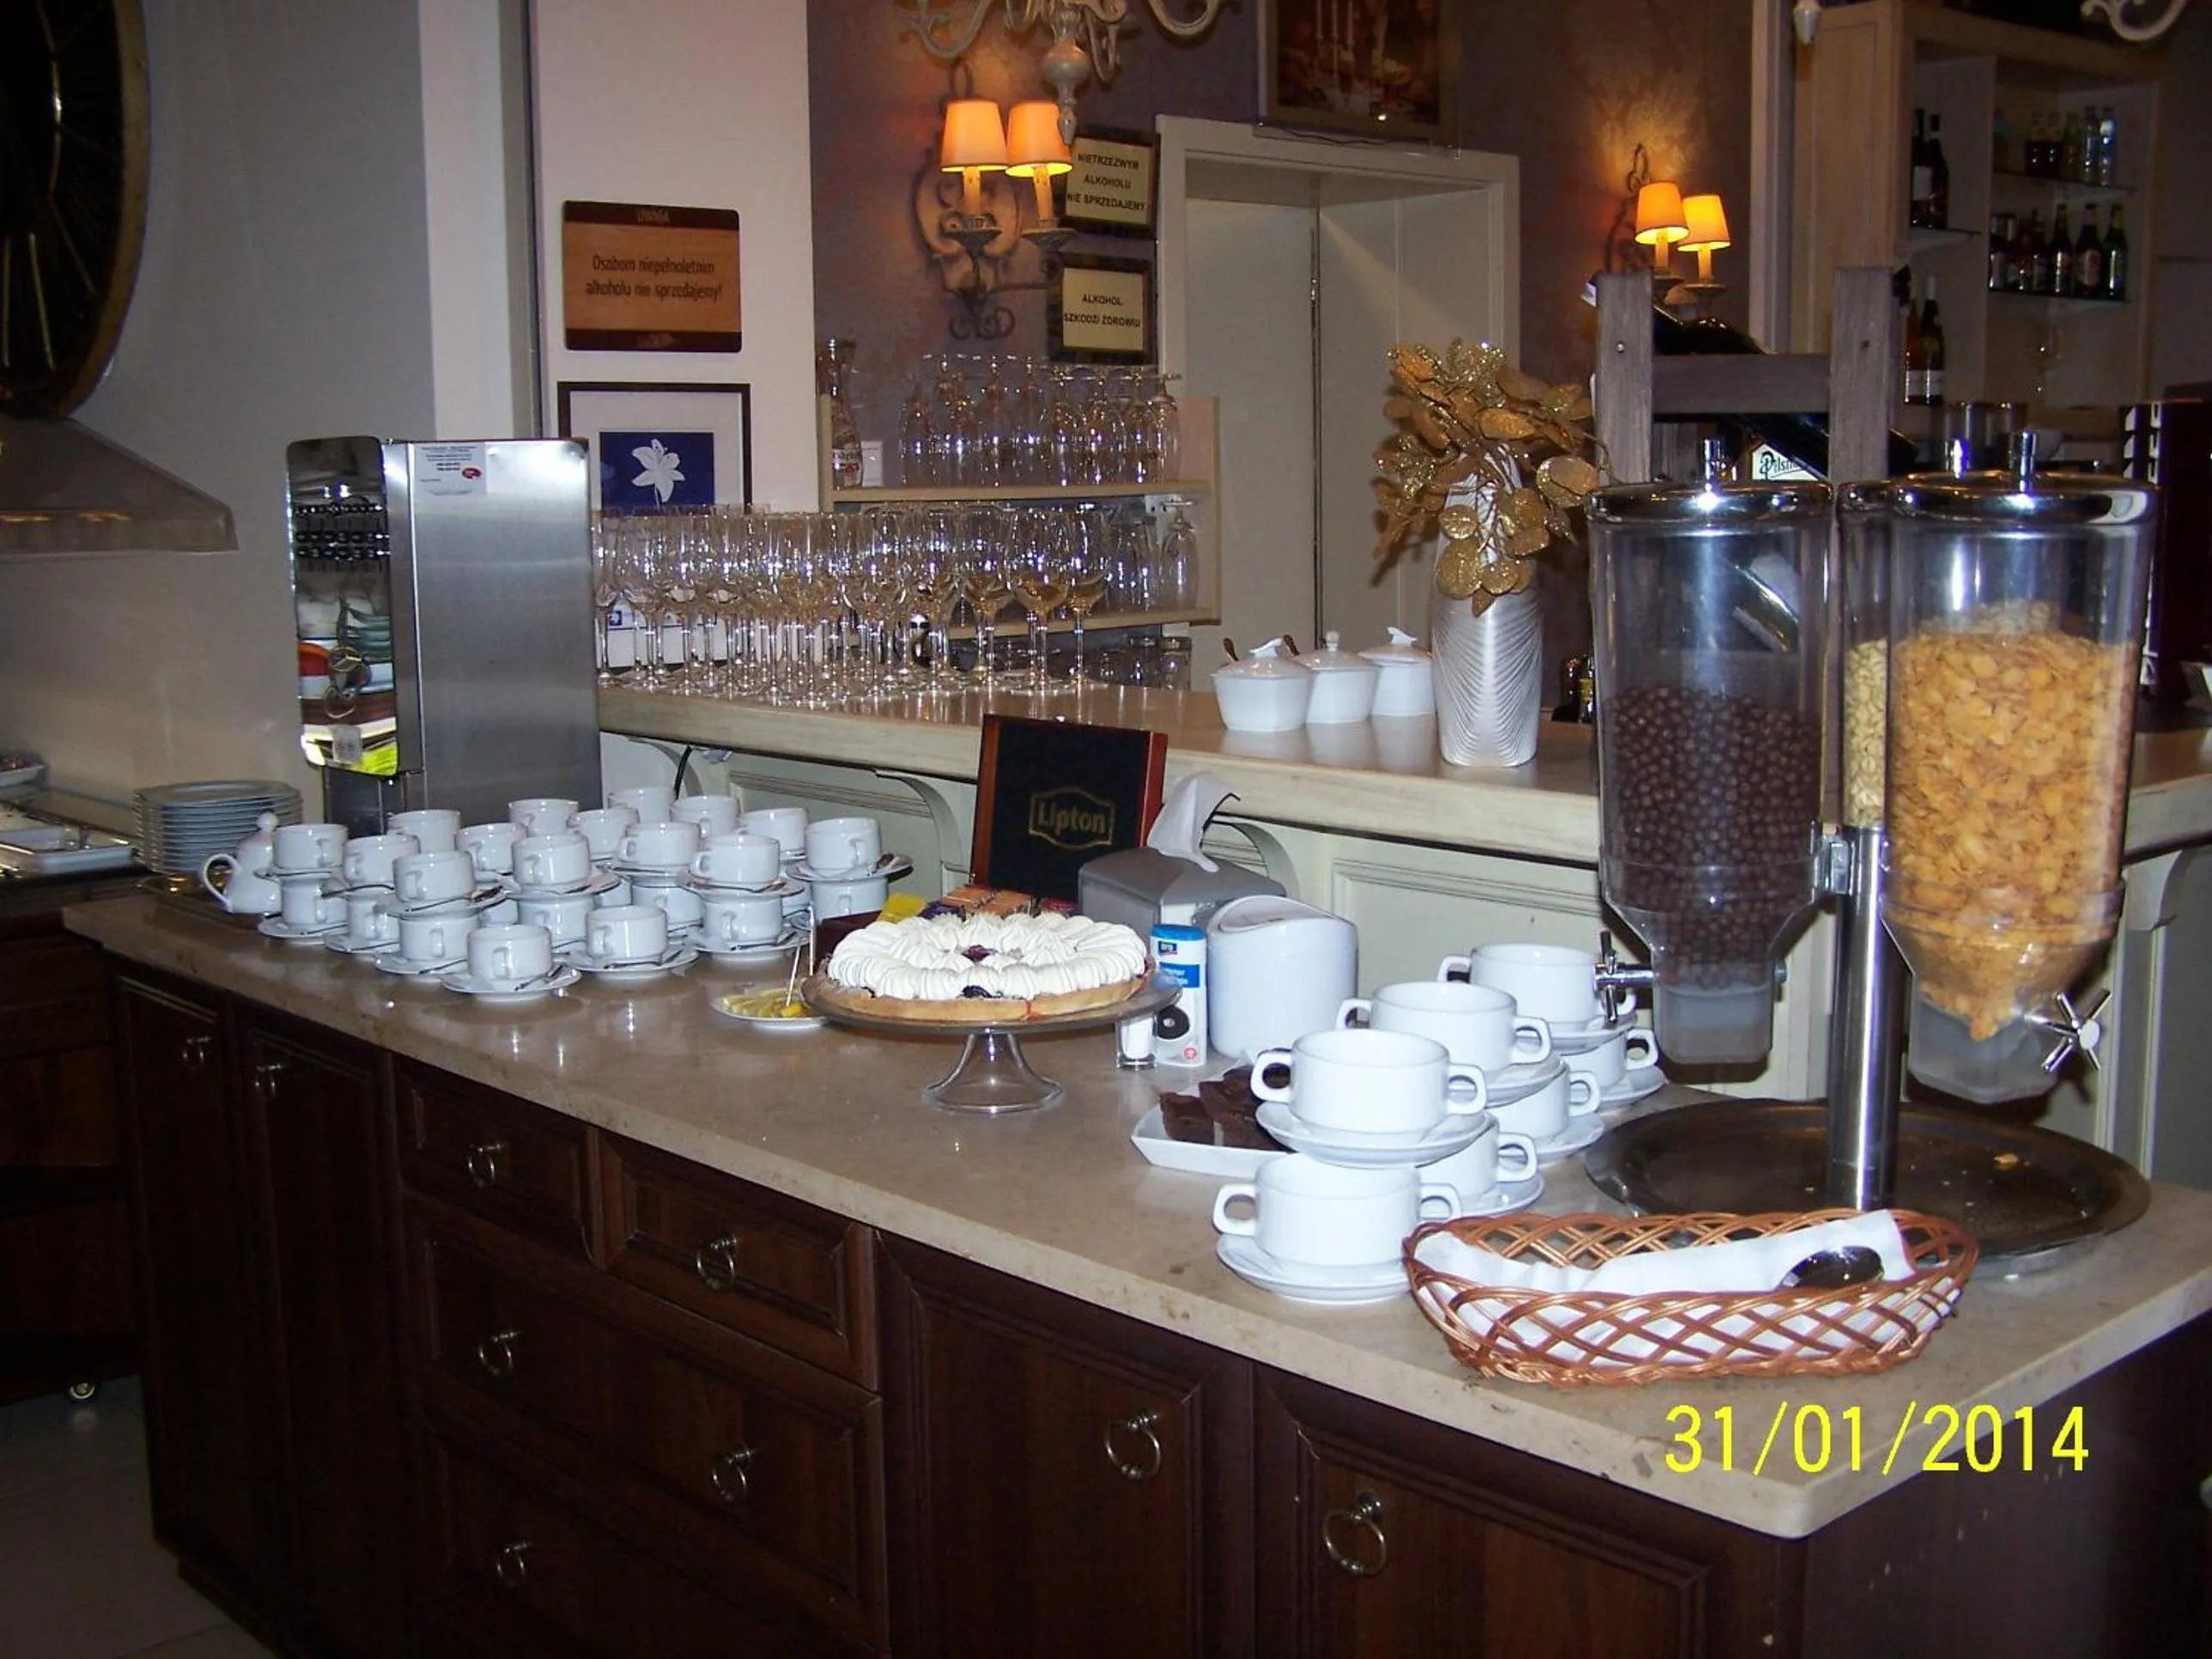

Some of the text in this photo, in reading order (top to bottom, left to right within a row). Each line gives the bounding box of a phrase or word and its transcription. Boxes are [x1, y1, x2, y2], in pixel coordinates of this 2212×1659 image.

[1084, 173, 1131, 189] ALKOHOLU
[1066, 192, 1145, 211] NIE SPRZEDAJEMY
[592, 254, 635, 271] Osobom
[1082, 295, 1123, 306] ALKOHOL
[1064, 313, 1140, 327] SZKODZI ZDROWIU
[1038, 799, 1105, 836] Lipton
